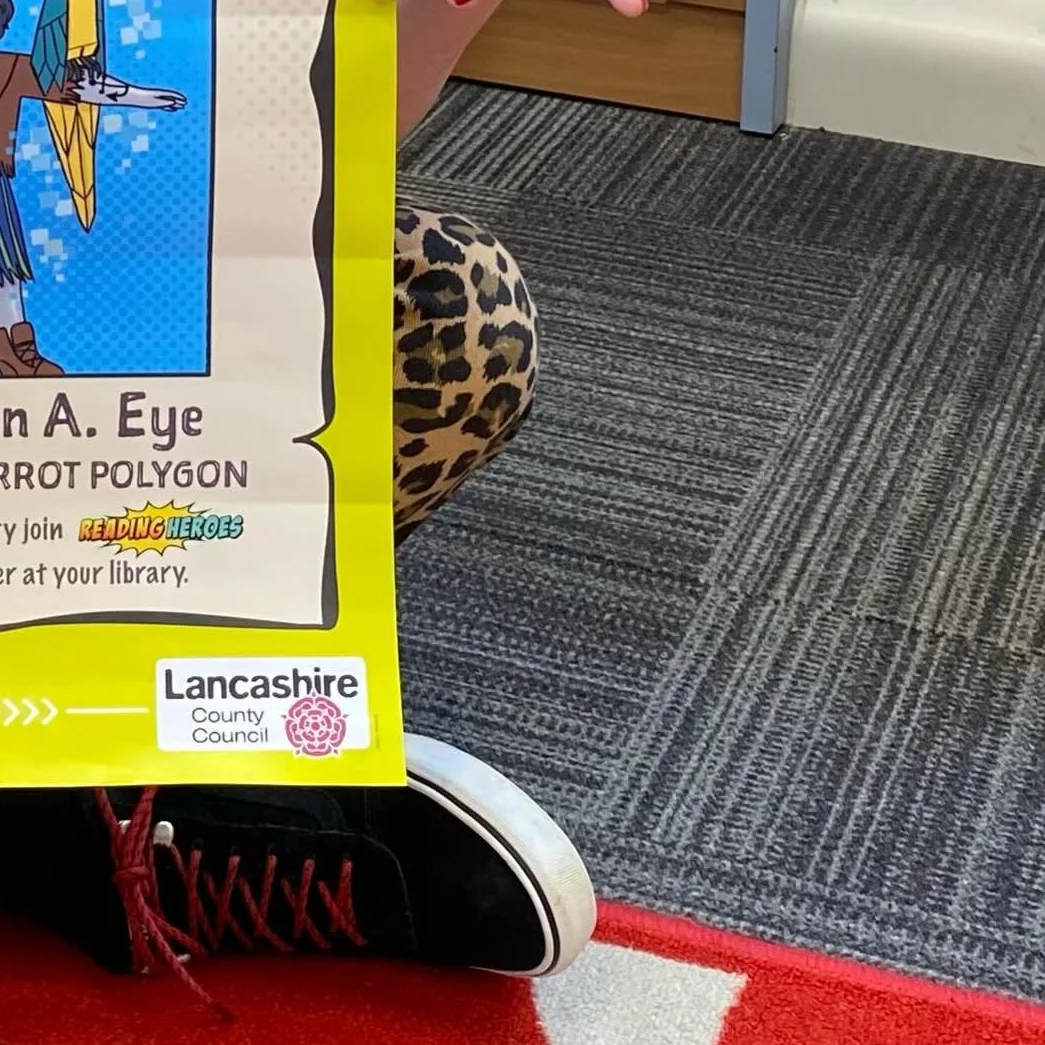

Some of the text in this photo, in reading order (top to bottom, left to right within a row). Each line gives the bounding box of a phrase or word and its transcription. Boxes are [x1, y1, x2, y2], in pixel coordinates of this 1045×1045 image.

[43, 392, 97, 438] A.
[118, 391, 203, 451] Eye
[91, 460, 247, 489] POLYGON
[22, 517, 63, 544] join
[23, 564, 47, 585] at
[53, 567, 101, 589] your
[109, 560, 189, 588] library.
[165, 667, 359, 700] Lancashire
[191, 707, 265, 726] County
[192, 727, 269, 744] Council
